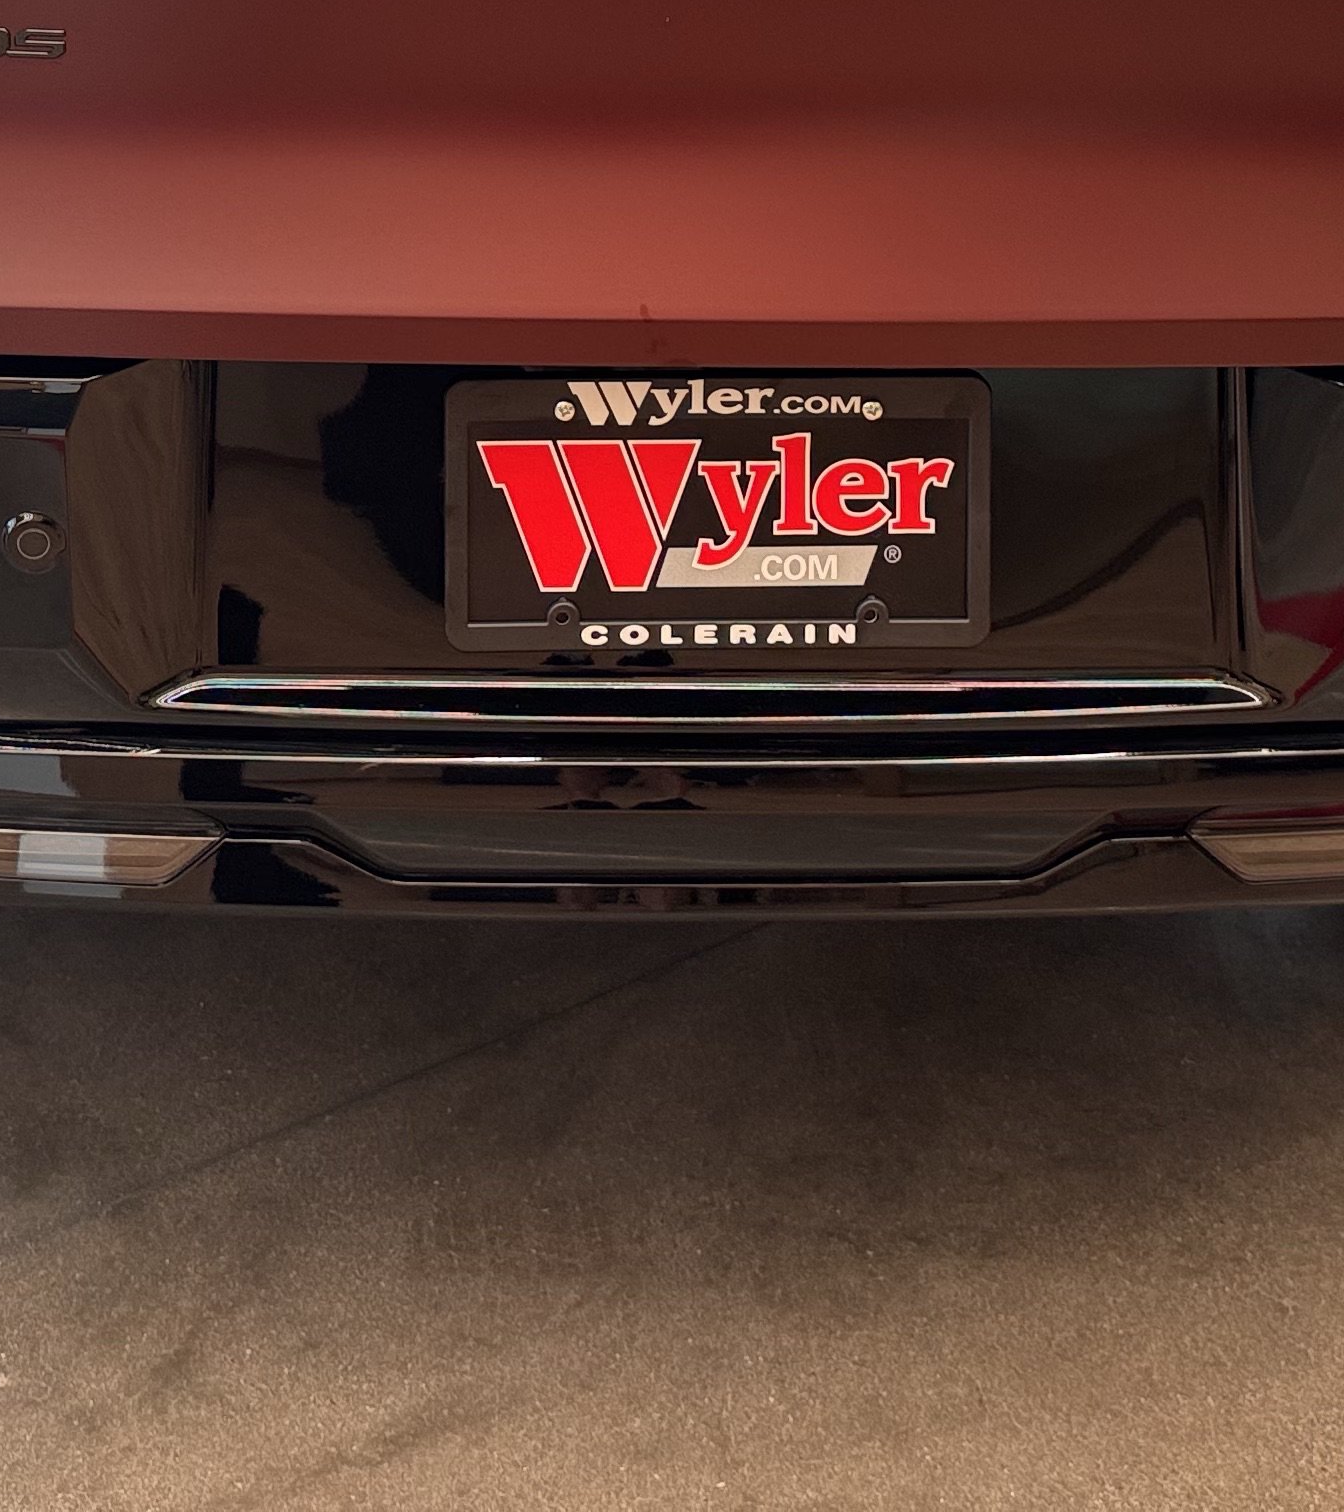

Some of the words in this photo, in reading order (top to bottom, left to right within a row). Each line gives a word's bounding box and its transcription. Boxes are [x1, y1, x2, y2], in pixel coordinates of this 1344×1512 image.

[476, 432, 955, 592] Wyler
[753, 554, 839, 582] .COM
[580, 624, 857, 647] COLERAIN
